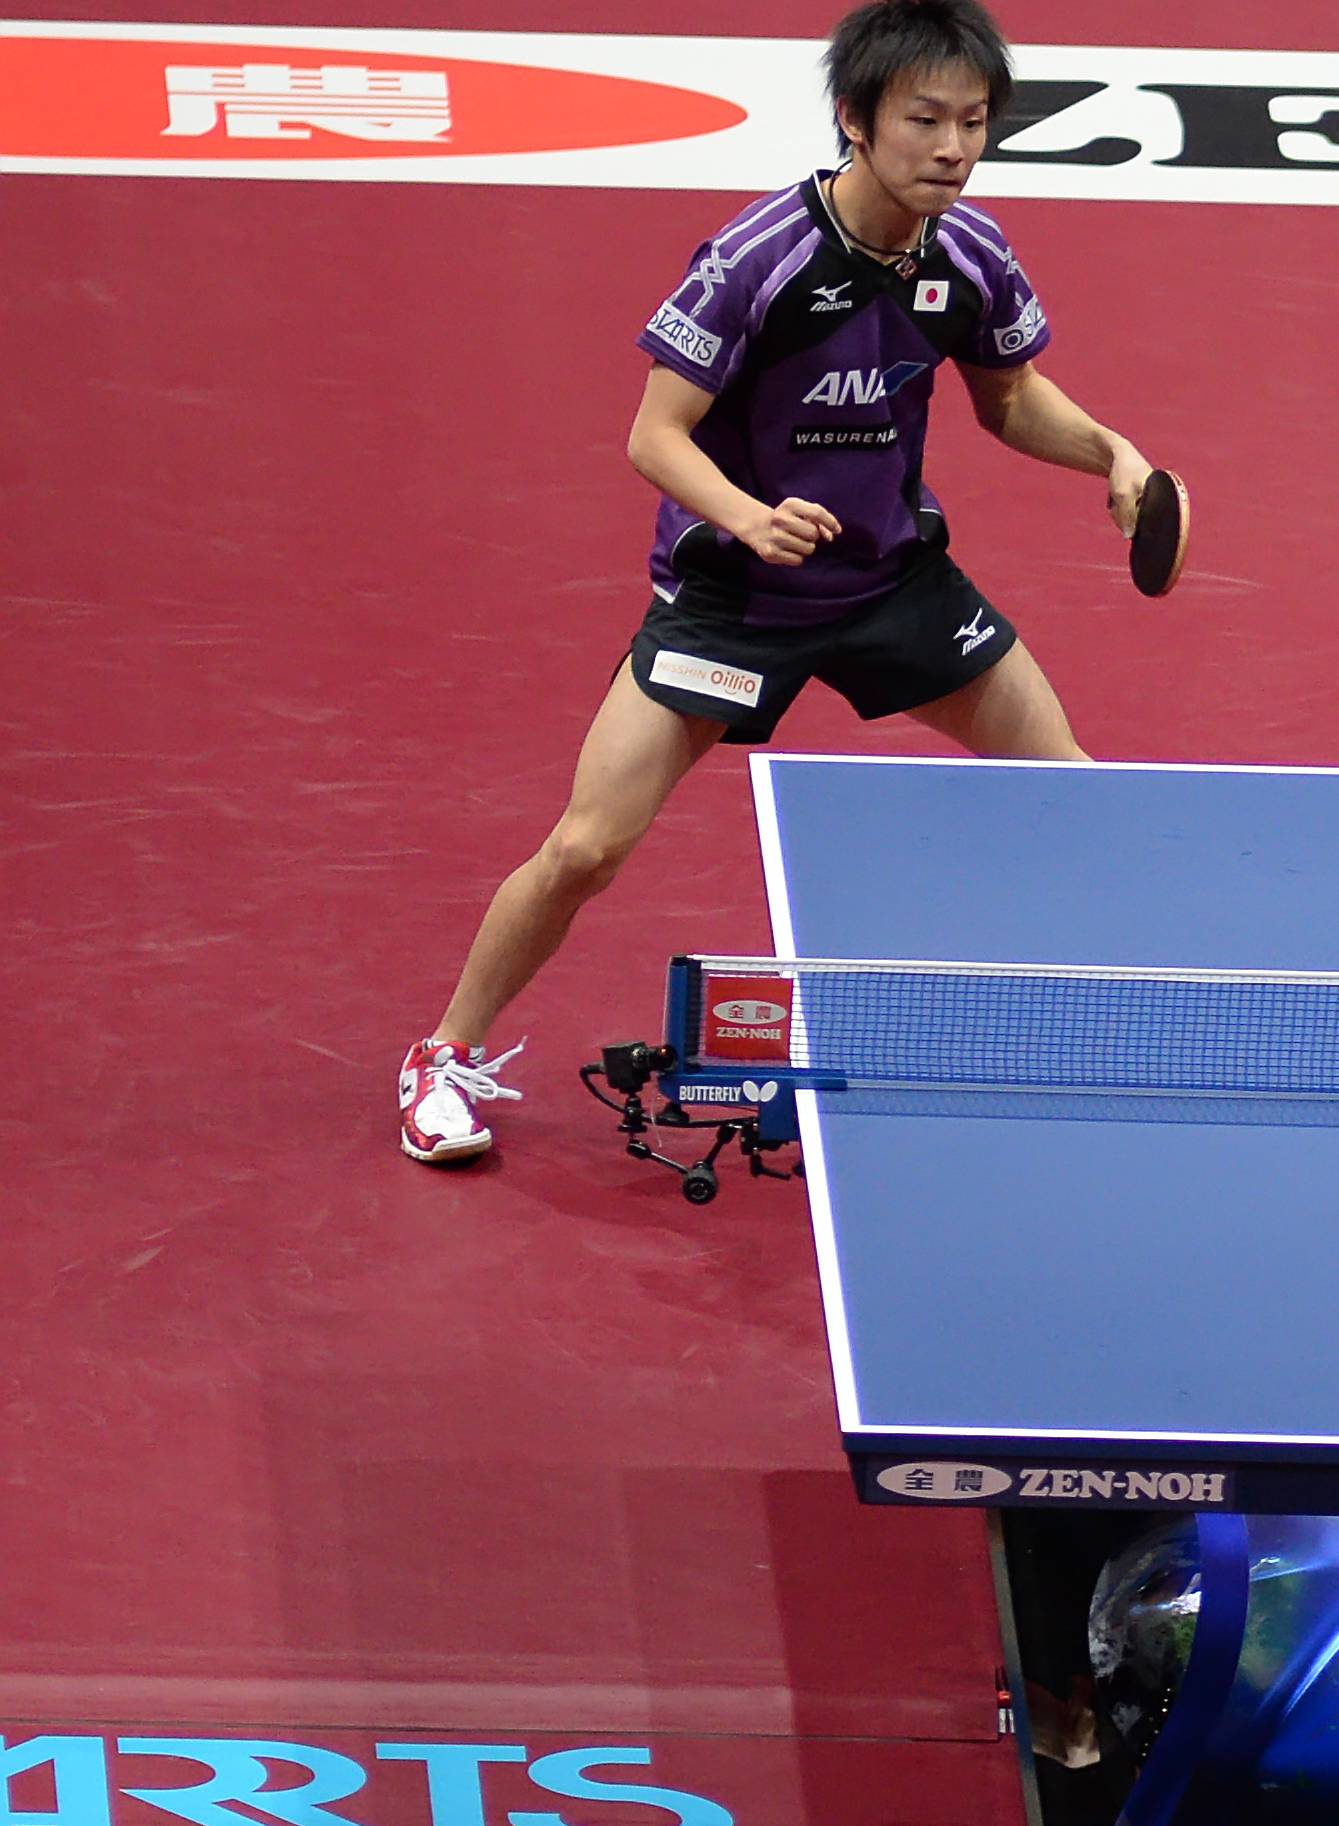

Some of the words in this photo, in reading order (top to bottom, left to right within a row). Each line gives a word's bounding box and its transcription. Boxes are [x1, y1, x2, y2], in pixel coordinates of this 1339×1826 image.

[716, 1026, 782, 1041] ZEN-NOH
[679, 1085, 743, 1102] BUTTERFLY
[1019, 1469, 1225, 1502] ZEN-NOH
